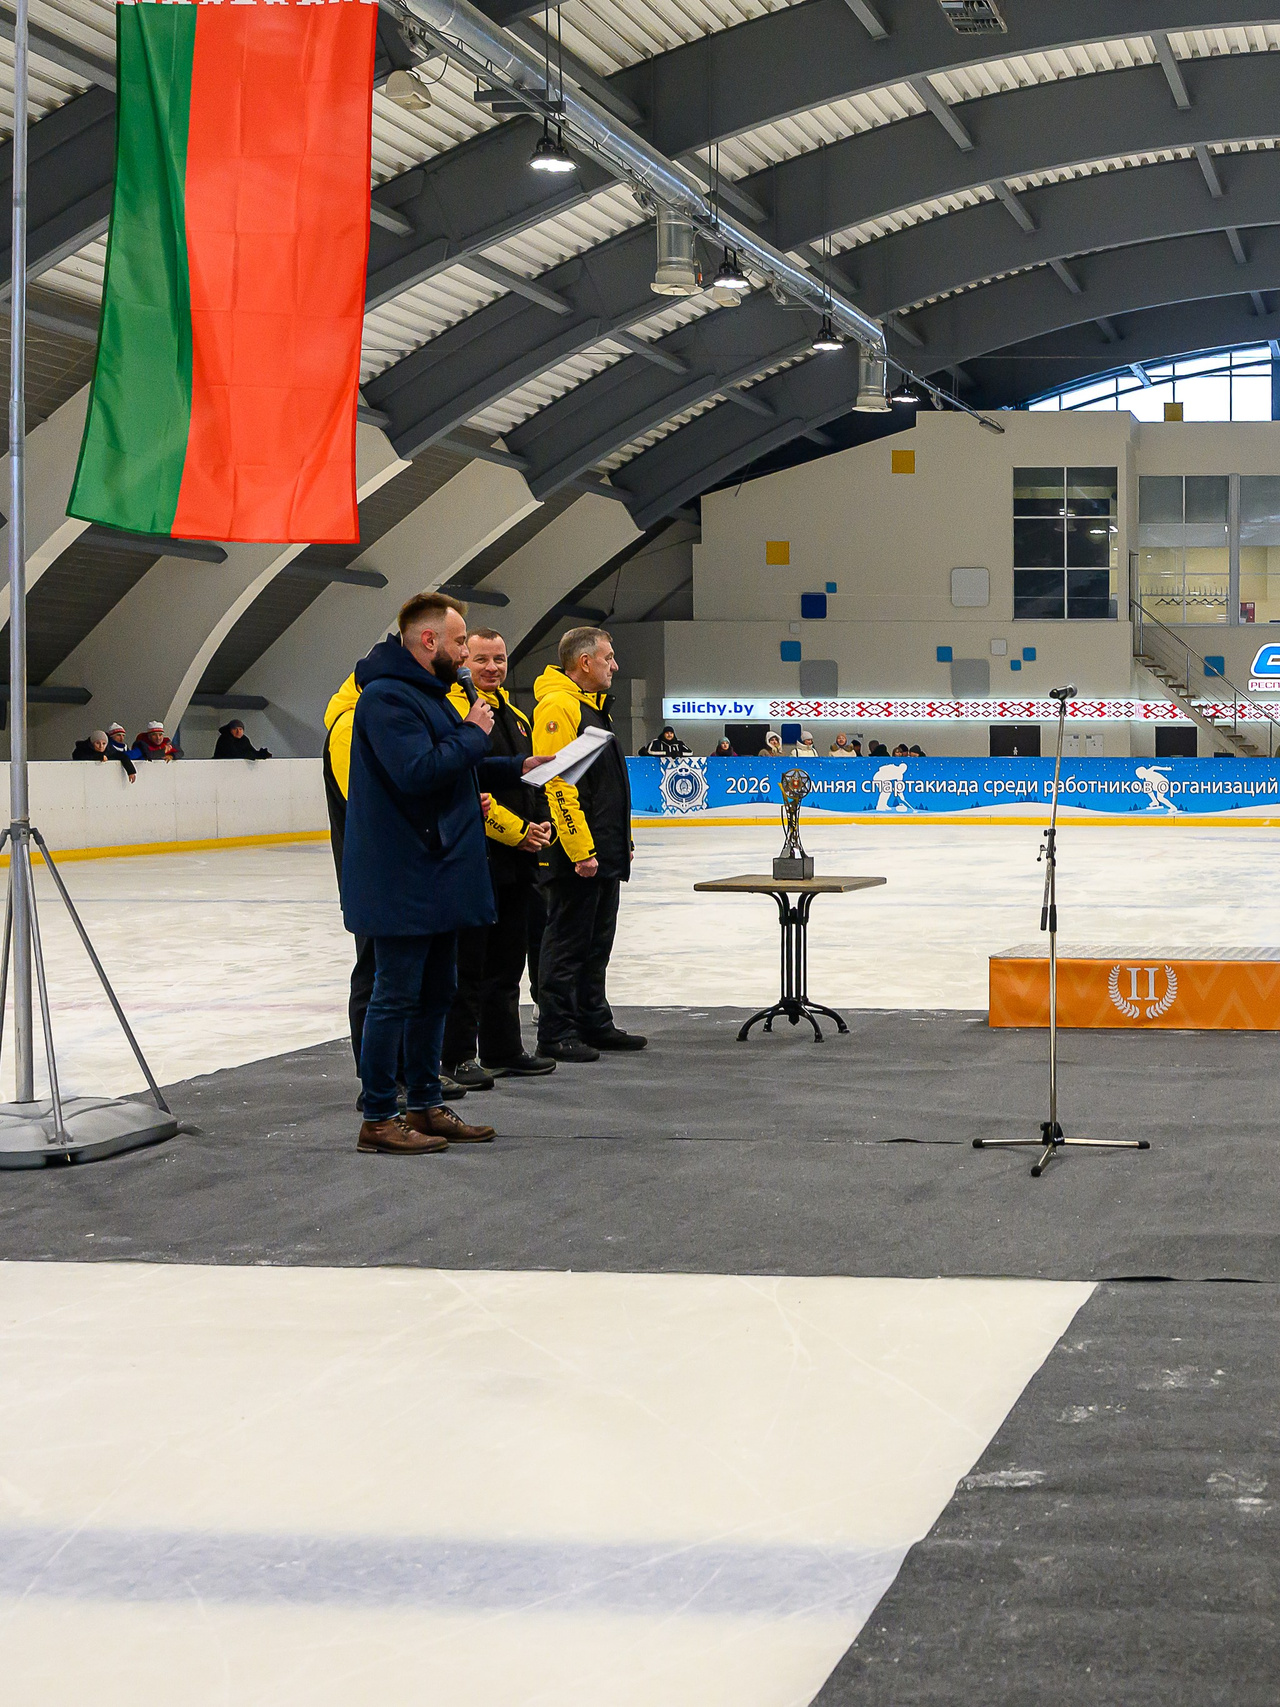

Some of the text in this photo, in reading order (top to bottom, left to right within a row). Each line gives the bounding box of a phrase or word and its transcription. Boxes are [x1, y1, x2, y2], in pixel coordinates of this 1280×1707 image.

[672, 701, 754, 716] silichy.by
[726, 777, 771, 794] 2026
[810, 780, 857, 793] мняя
[861, 780, 979, 797] спартакиада
[983, 780, 1038, 797] среди
[1043, 774, 1153, 797] работников
[1157, 777, 1278, 798] организаций
[484, 815, 506, 834] ARUS
[555, 790, 578, 836] BELARUS
[1126, 967, 1159, 1001] II
